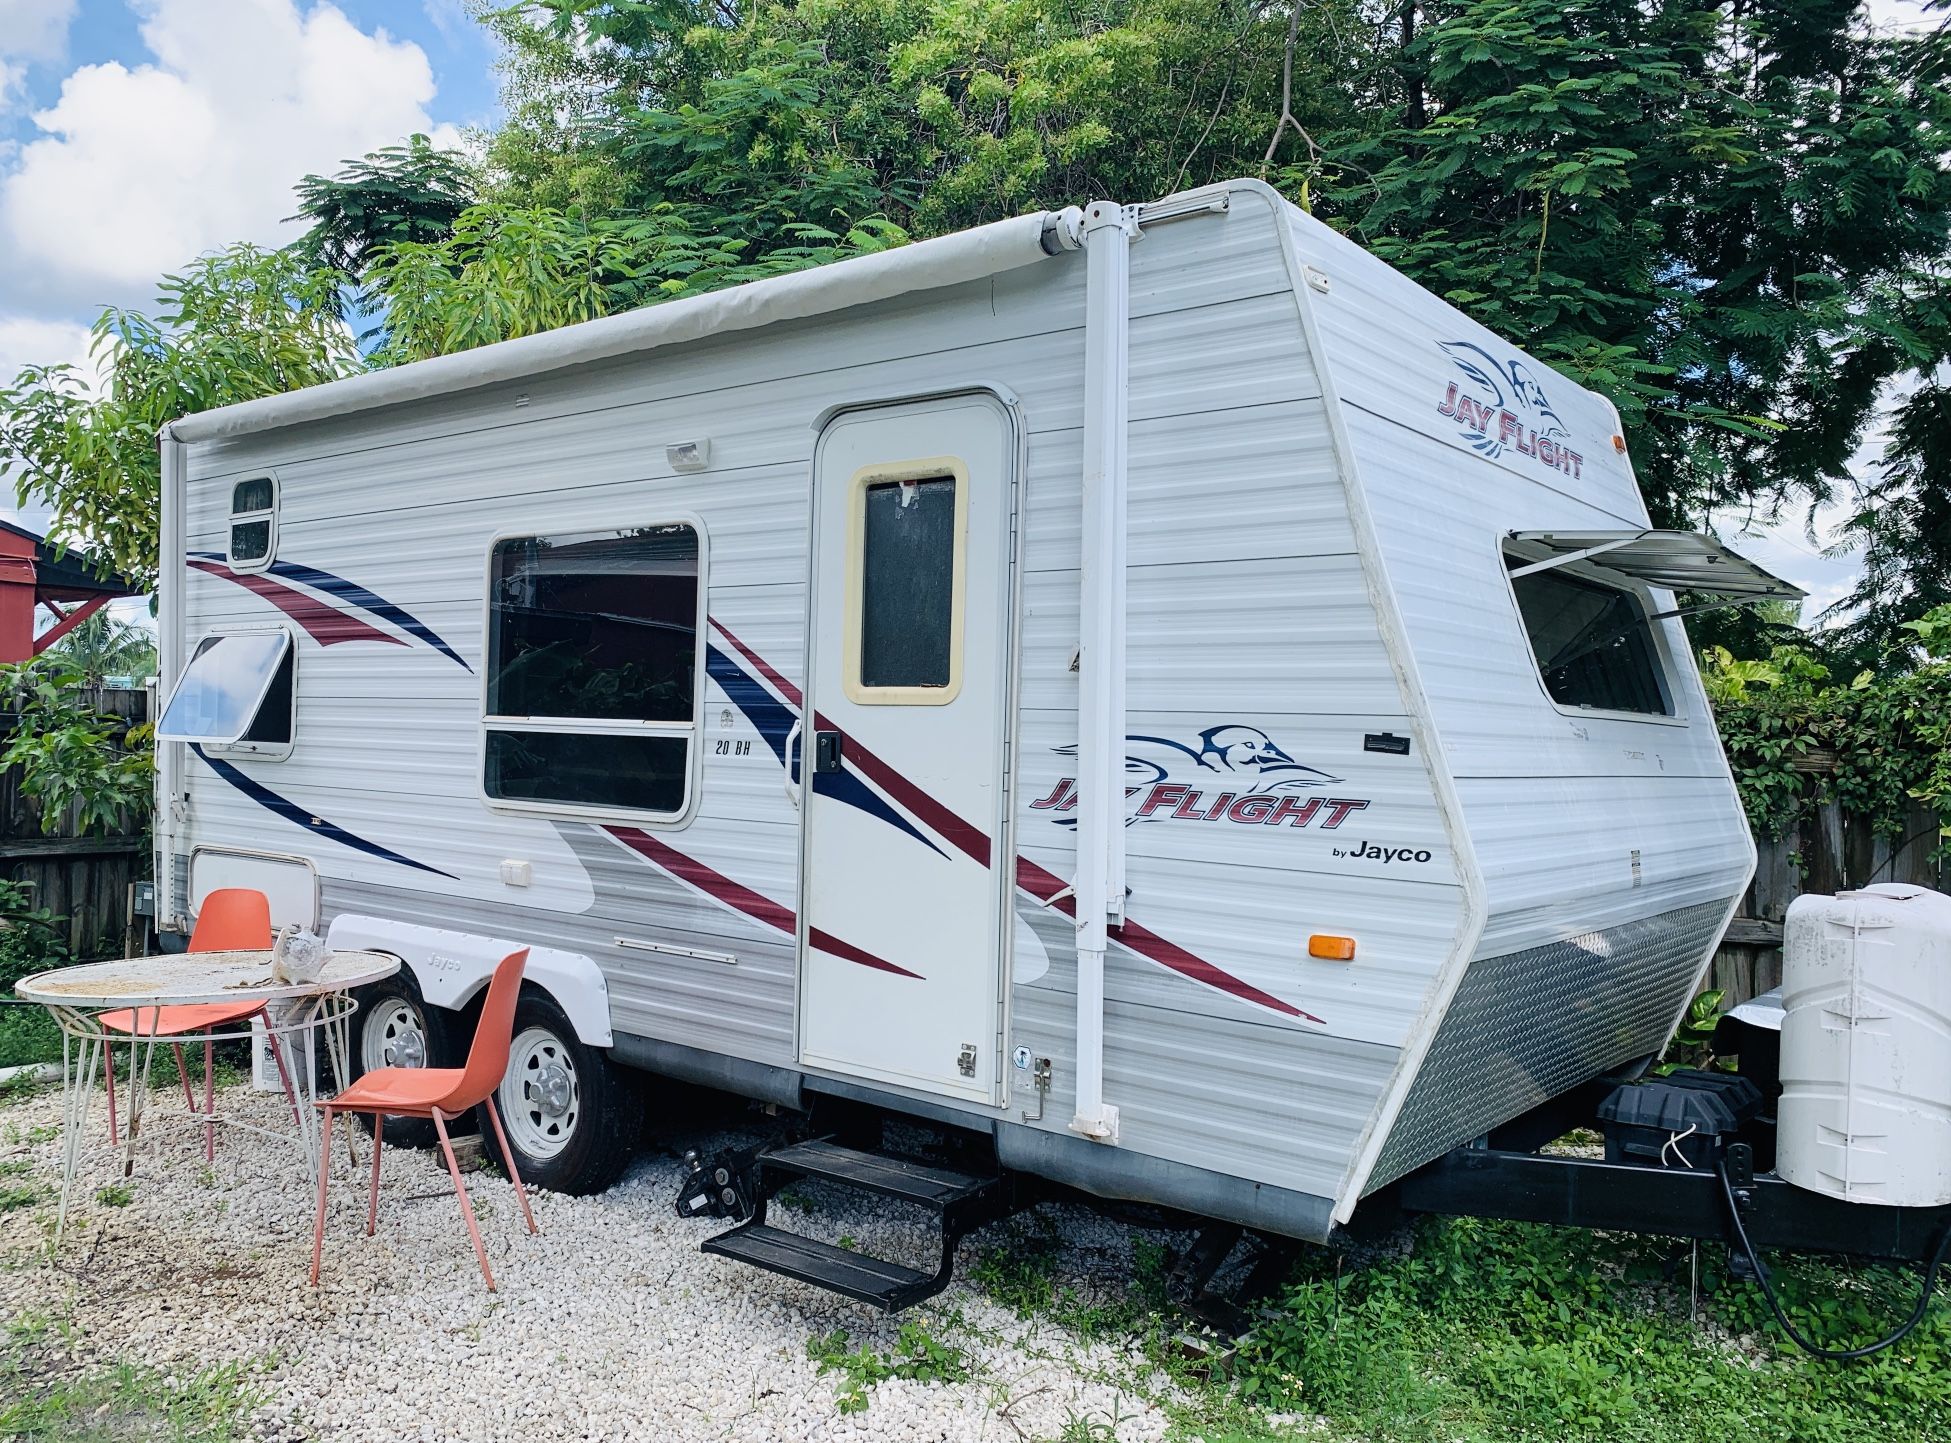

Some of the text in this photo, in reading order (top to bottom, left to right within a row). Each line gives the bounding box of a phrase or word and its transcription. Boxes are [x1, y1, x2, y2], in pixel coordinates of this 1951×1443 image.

[1437, 381, 1584, 480] JAY FLIGHT
[716, 740, 750, 756] 20 BH
[1135, 783, 1370, 829] FLIGHT
[1332, 841, 1432, 864] by Jayco
[428, 952, 462, 971] Jayco
